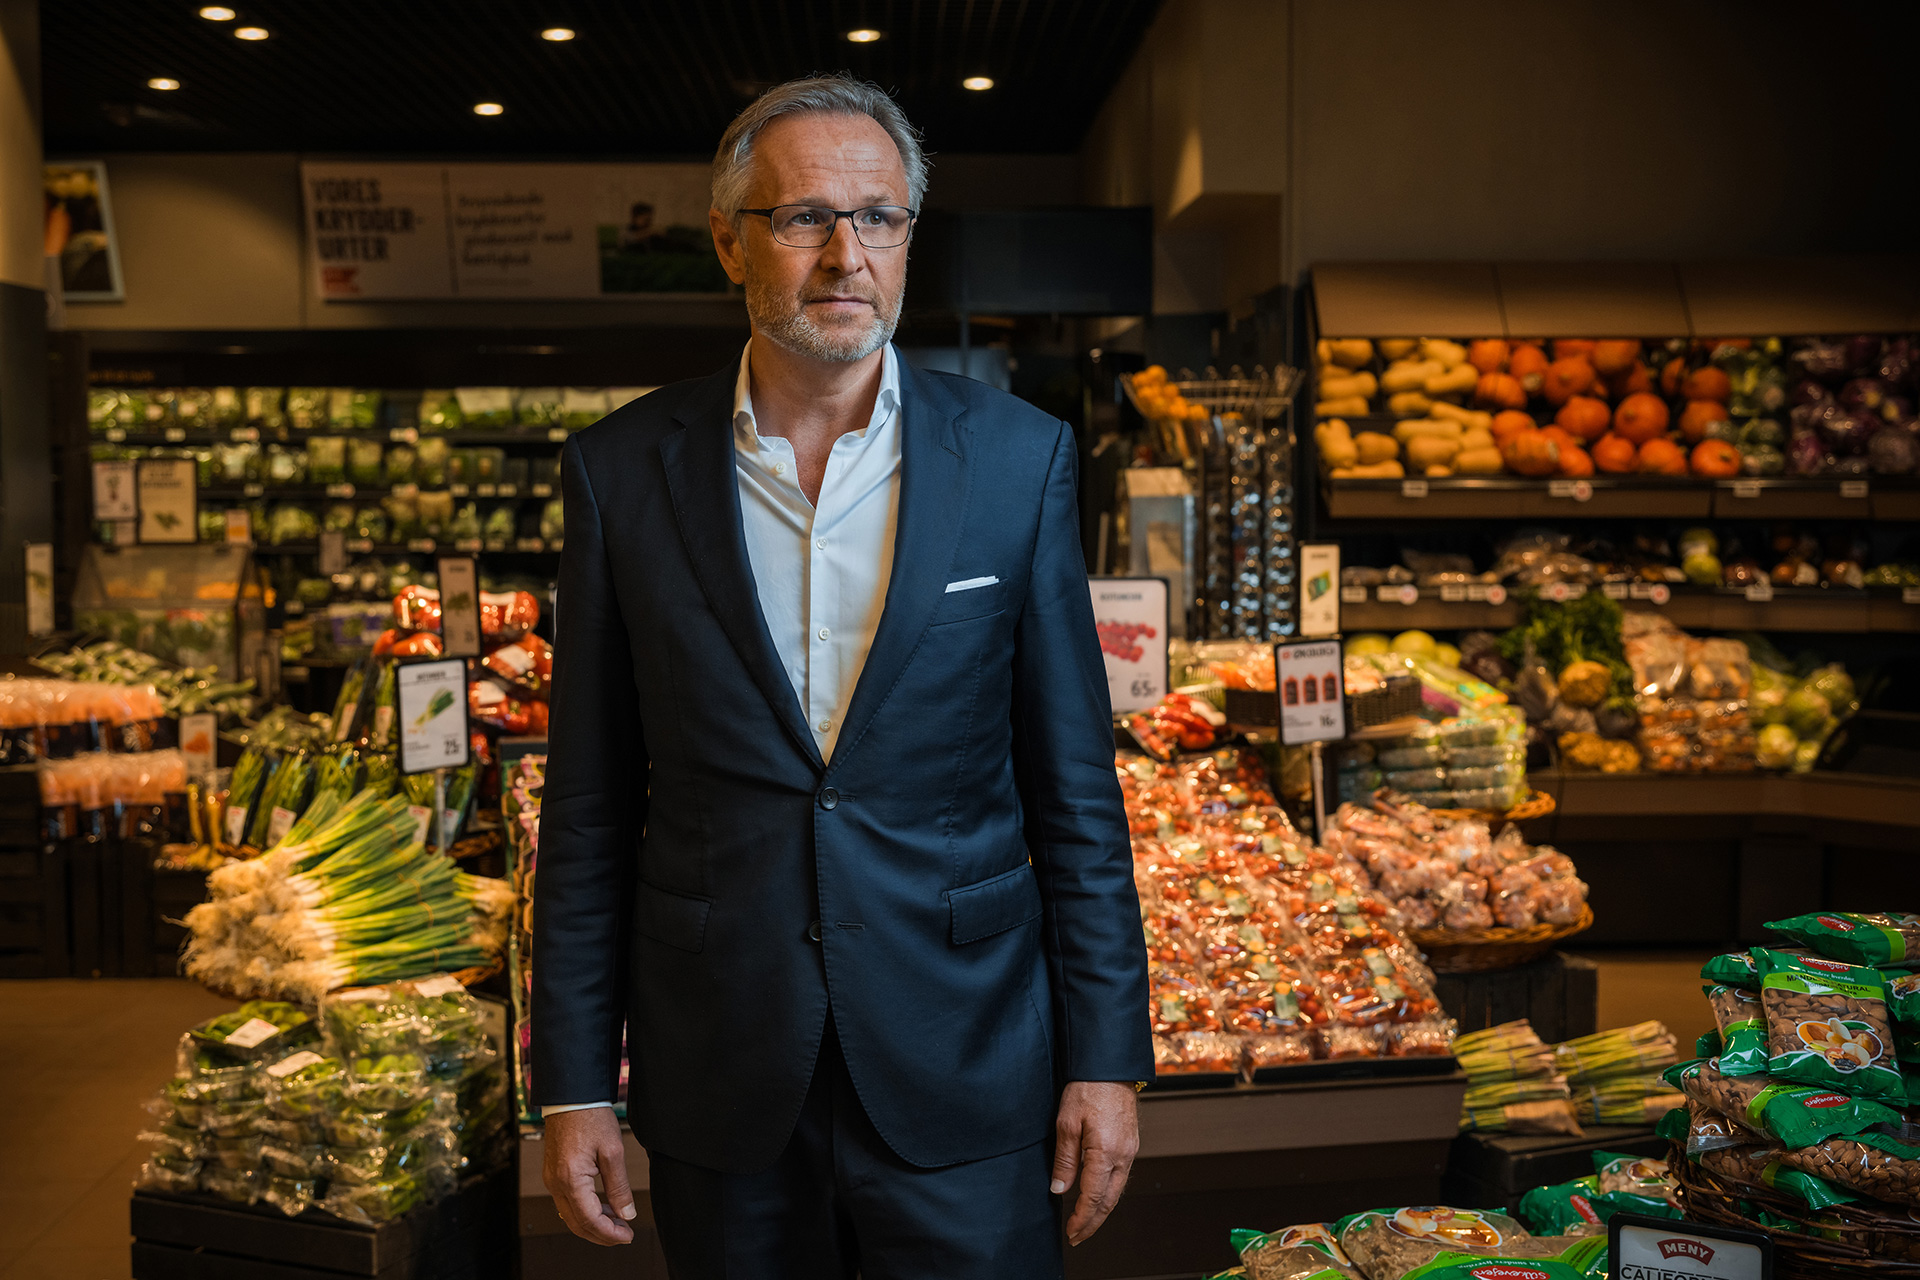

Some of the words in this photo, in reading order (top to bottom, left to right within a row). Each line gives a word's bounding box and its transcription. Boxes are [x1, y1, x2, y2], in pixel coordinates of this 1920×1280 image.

[311, 178, 382, 204] VORES
[317, 235, 389, 261] URTER
[1664, 1242, 1709, 1259] MENY
[1473, 1268, 1547, 1280] Silkevejen
